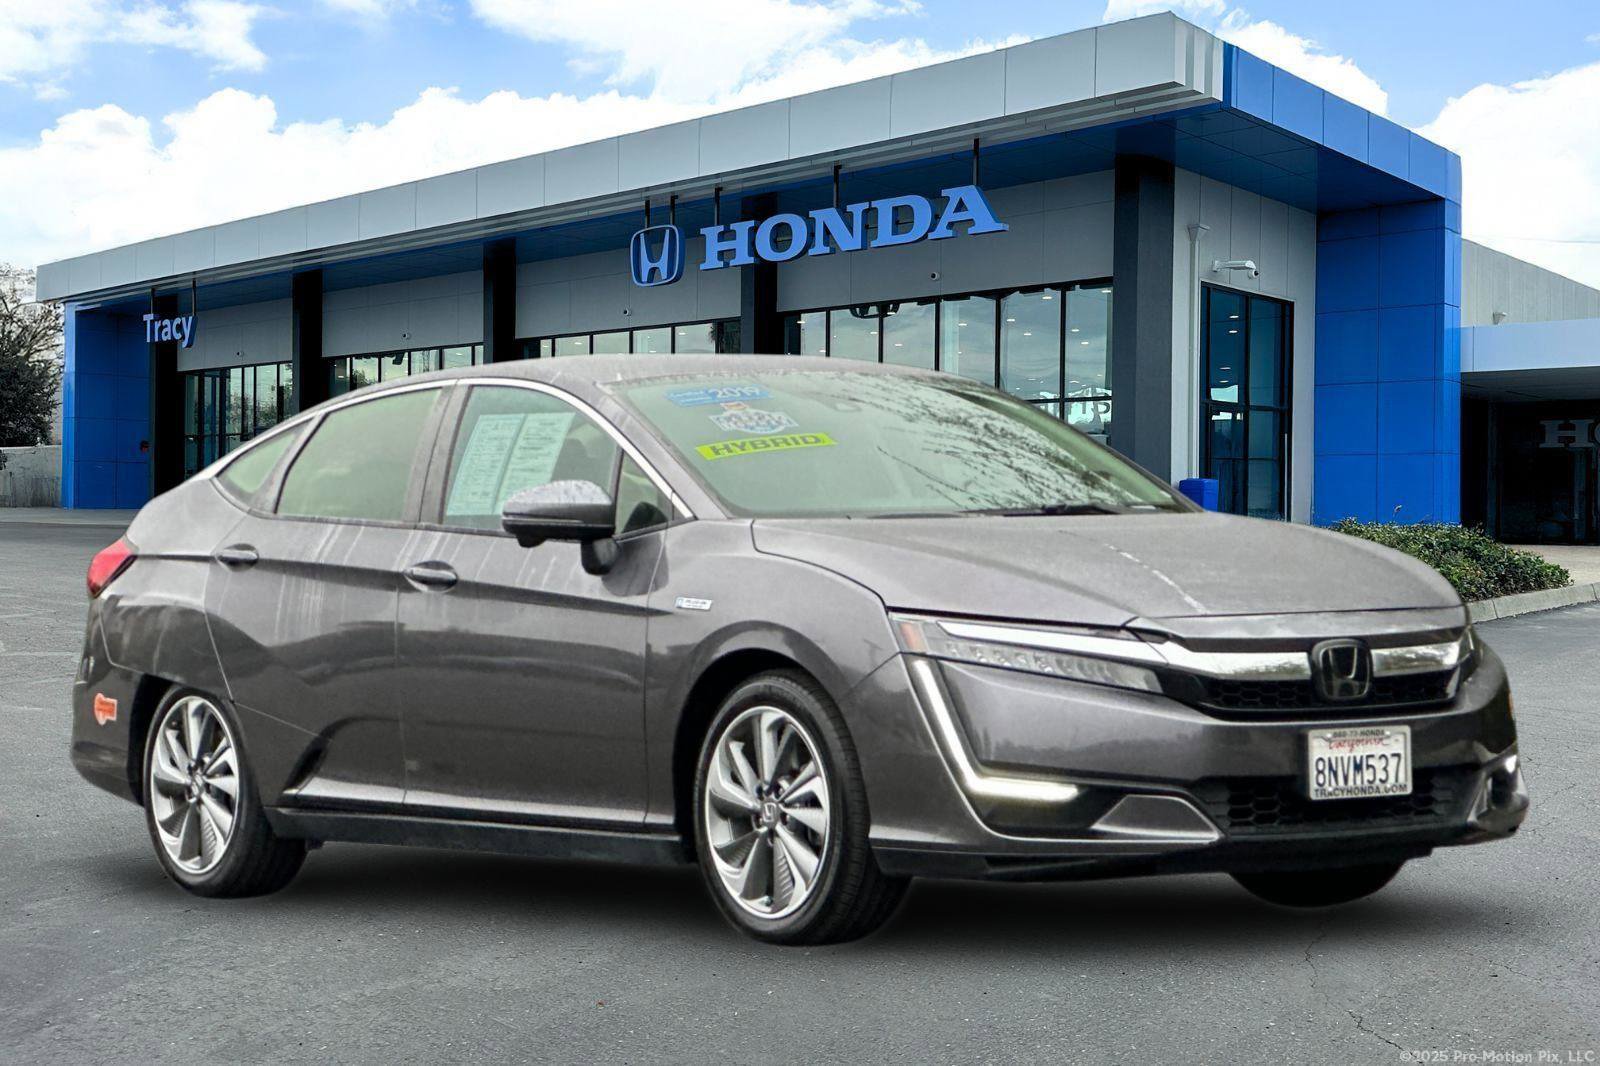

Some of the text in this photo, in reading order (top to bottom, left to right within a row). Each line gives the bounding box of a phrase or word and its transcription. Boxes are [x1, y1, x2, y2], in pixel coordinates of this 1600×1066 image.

[700, 184, 1010, 271] HONDA
[143, 313, 194, 348] Tracy
[709, 434, 822, 457] HYBRID
[1539, 419, 1600, 448] H
[1315, 753, 1402, 787] 8NVM537
[1314, 783, 1408, 798] TRACYHONDA.COM
